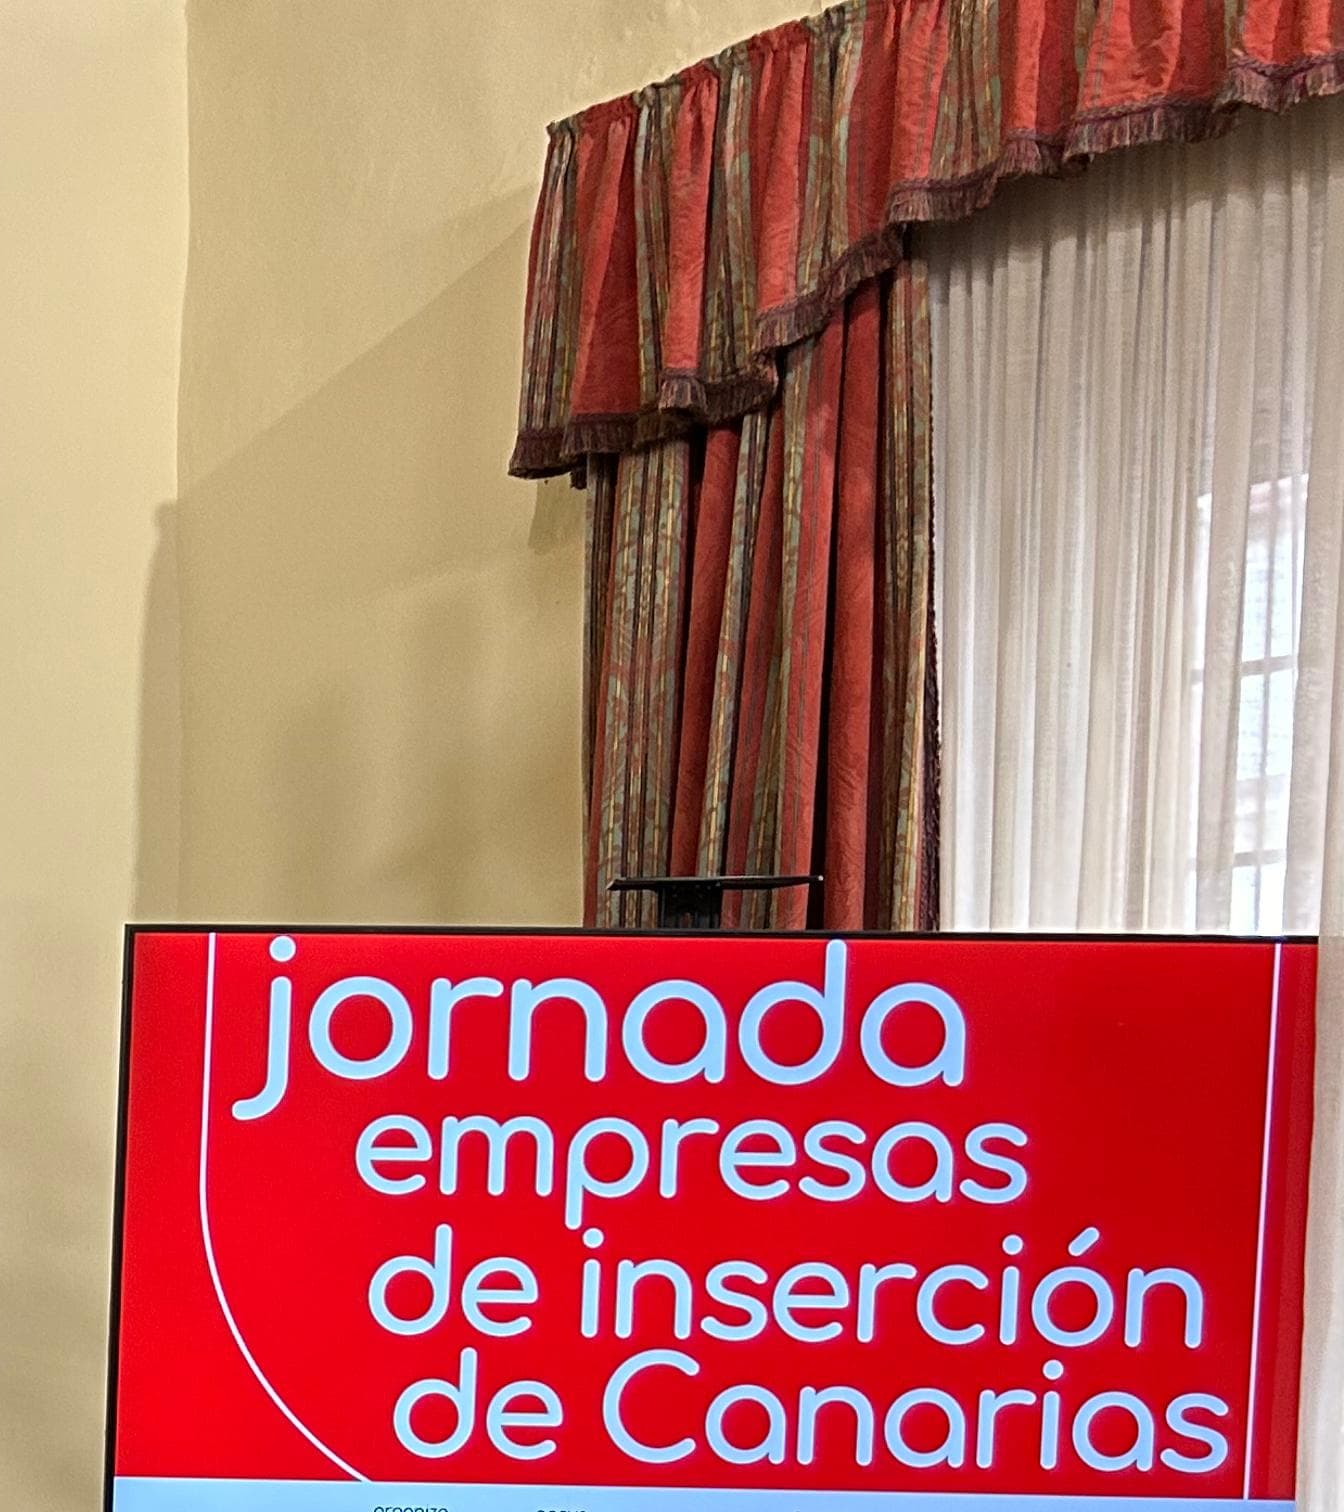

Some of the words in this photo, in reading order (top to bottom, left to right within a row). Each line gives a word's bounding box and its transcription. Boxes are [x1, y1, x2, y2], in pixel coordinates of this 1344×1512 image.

[232, 936, 965, 1120] jornada
[356, 1115, 1027, 1229] empresas
[369, 1224, 538, 1337] de
[581, 1227, 1203, 1348] inserción
[394, 1347, 563, 1460] de
[603, 1350, 1228, 1473] Canarias
